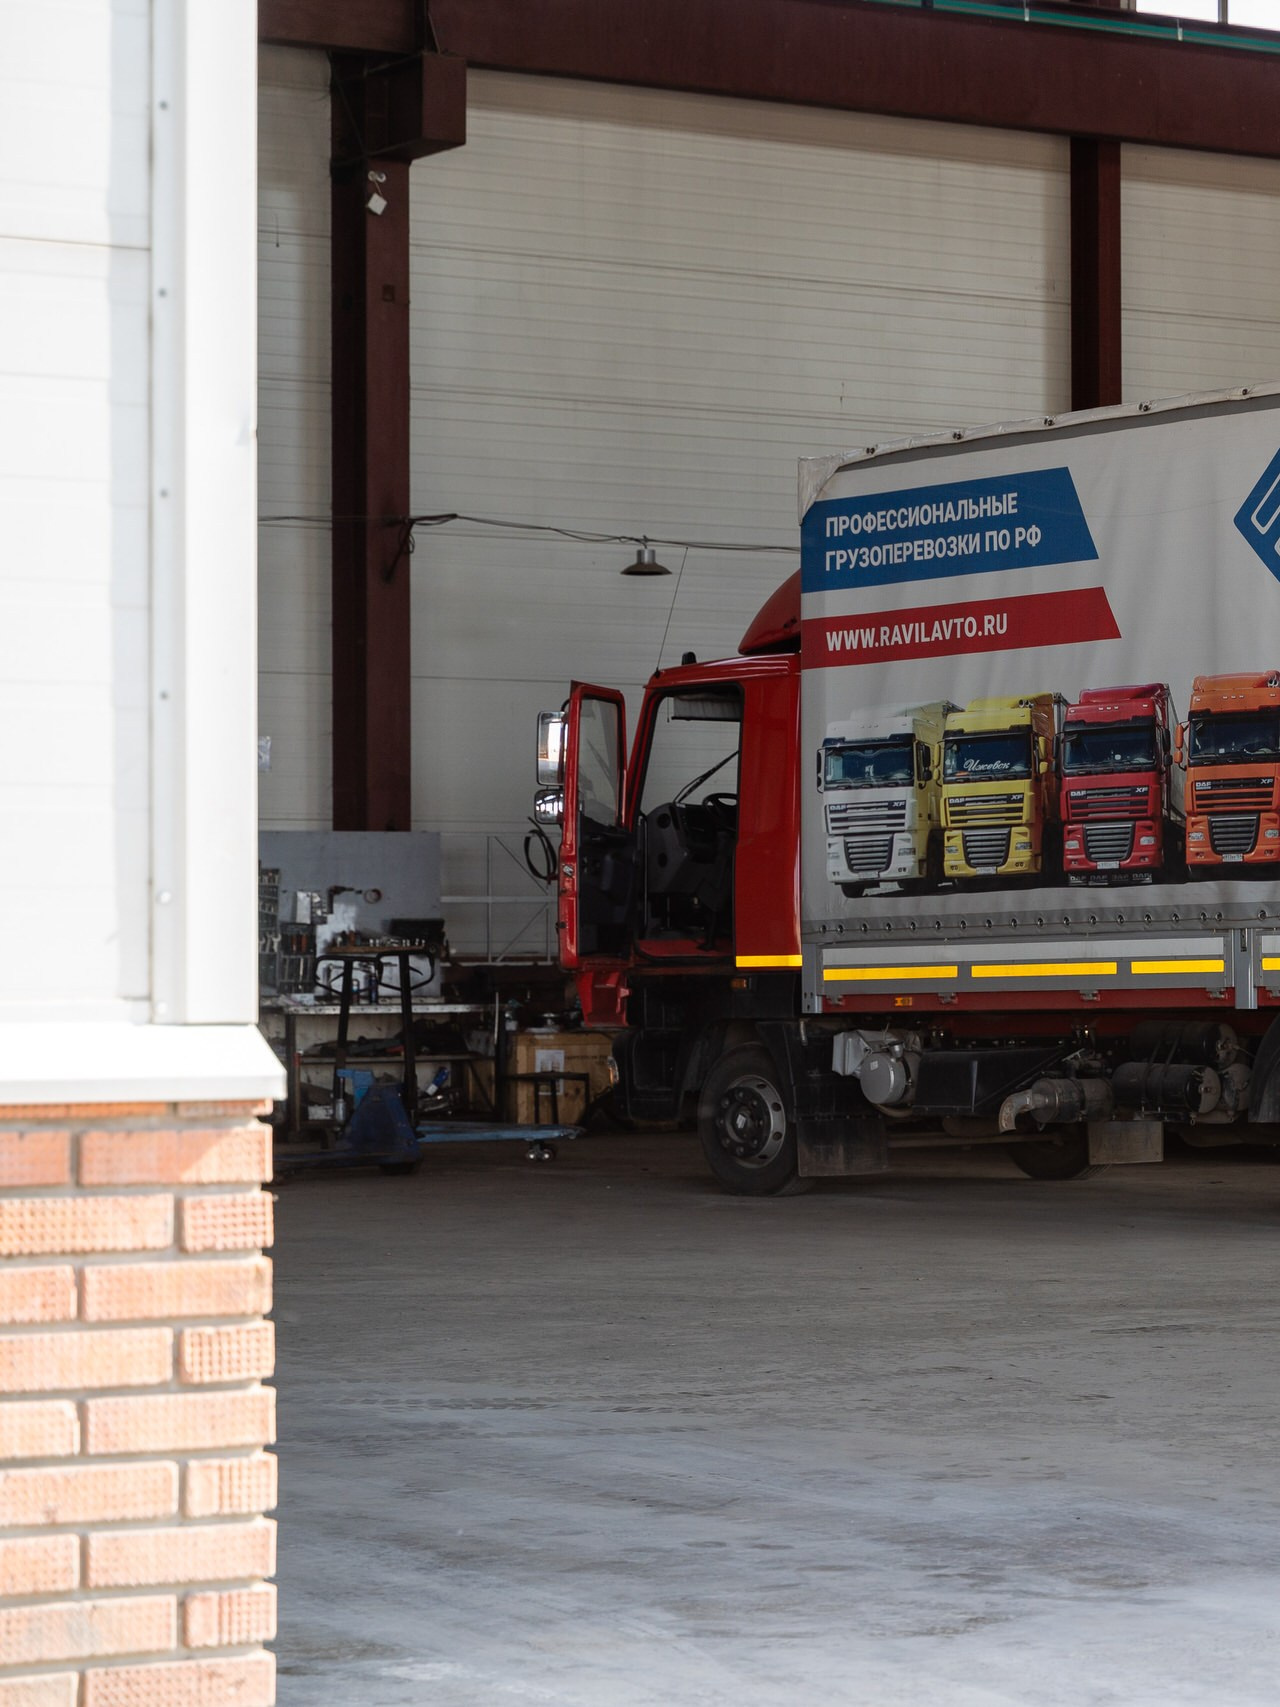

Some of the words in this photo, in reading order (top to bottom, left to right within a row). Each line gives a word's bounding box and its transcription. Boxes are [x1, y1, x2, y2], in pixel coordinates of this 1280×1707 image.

[826, 492, 1018, 537] ПРОФЕССИОНАЛЬНЫЕ
[826, 532, 980, 571] ГРУЗОПЕРЕВОЗКИ
[985, 528, 1011, 552] ПО
[1015, 525, 1041, 548] РФ
[826, 613, 1008, 652] WWW.RAVILAVTO.RU
